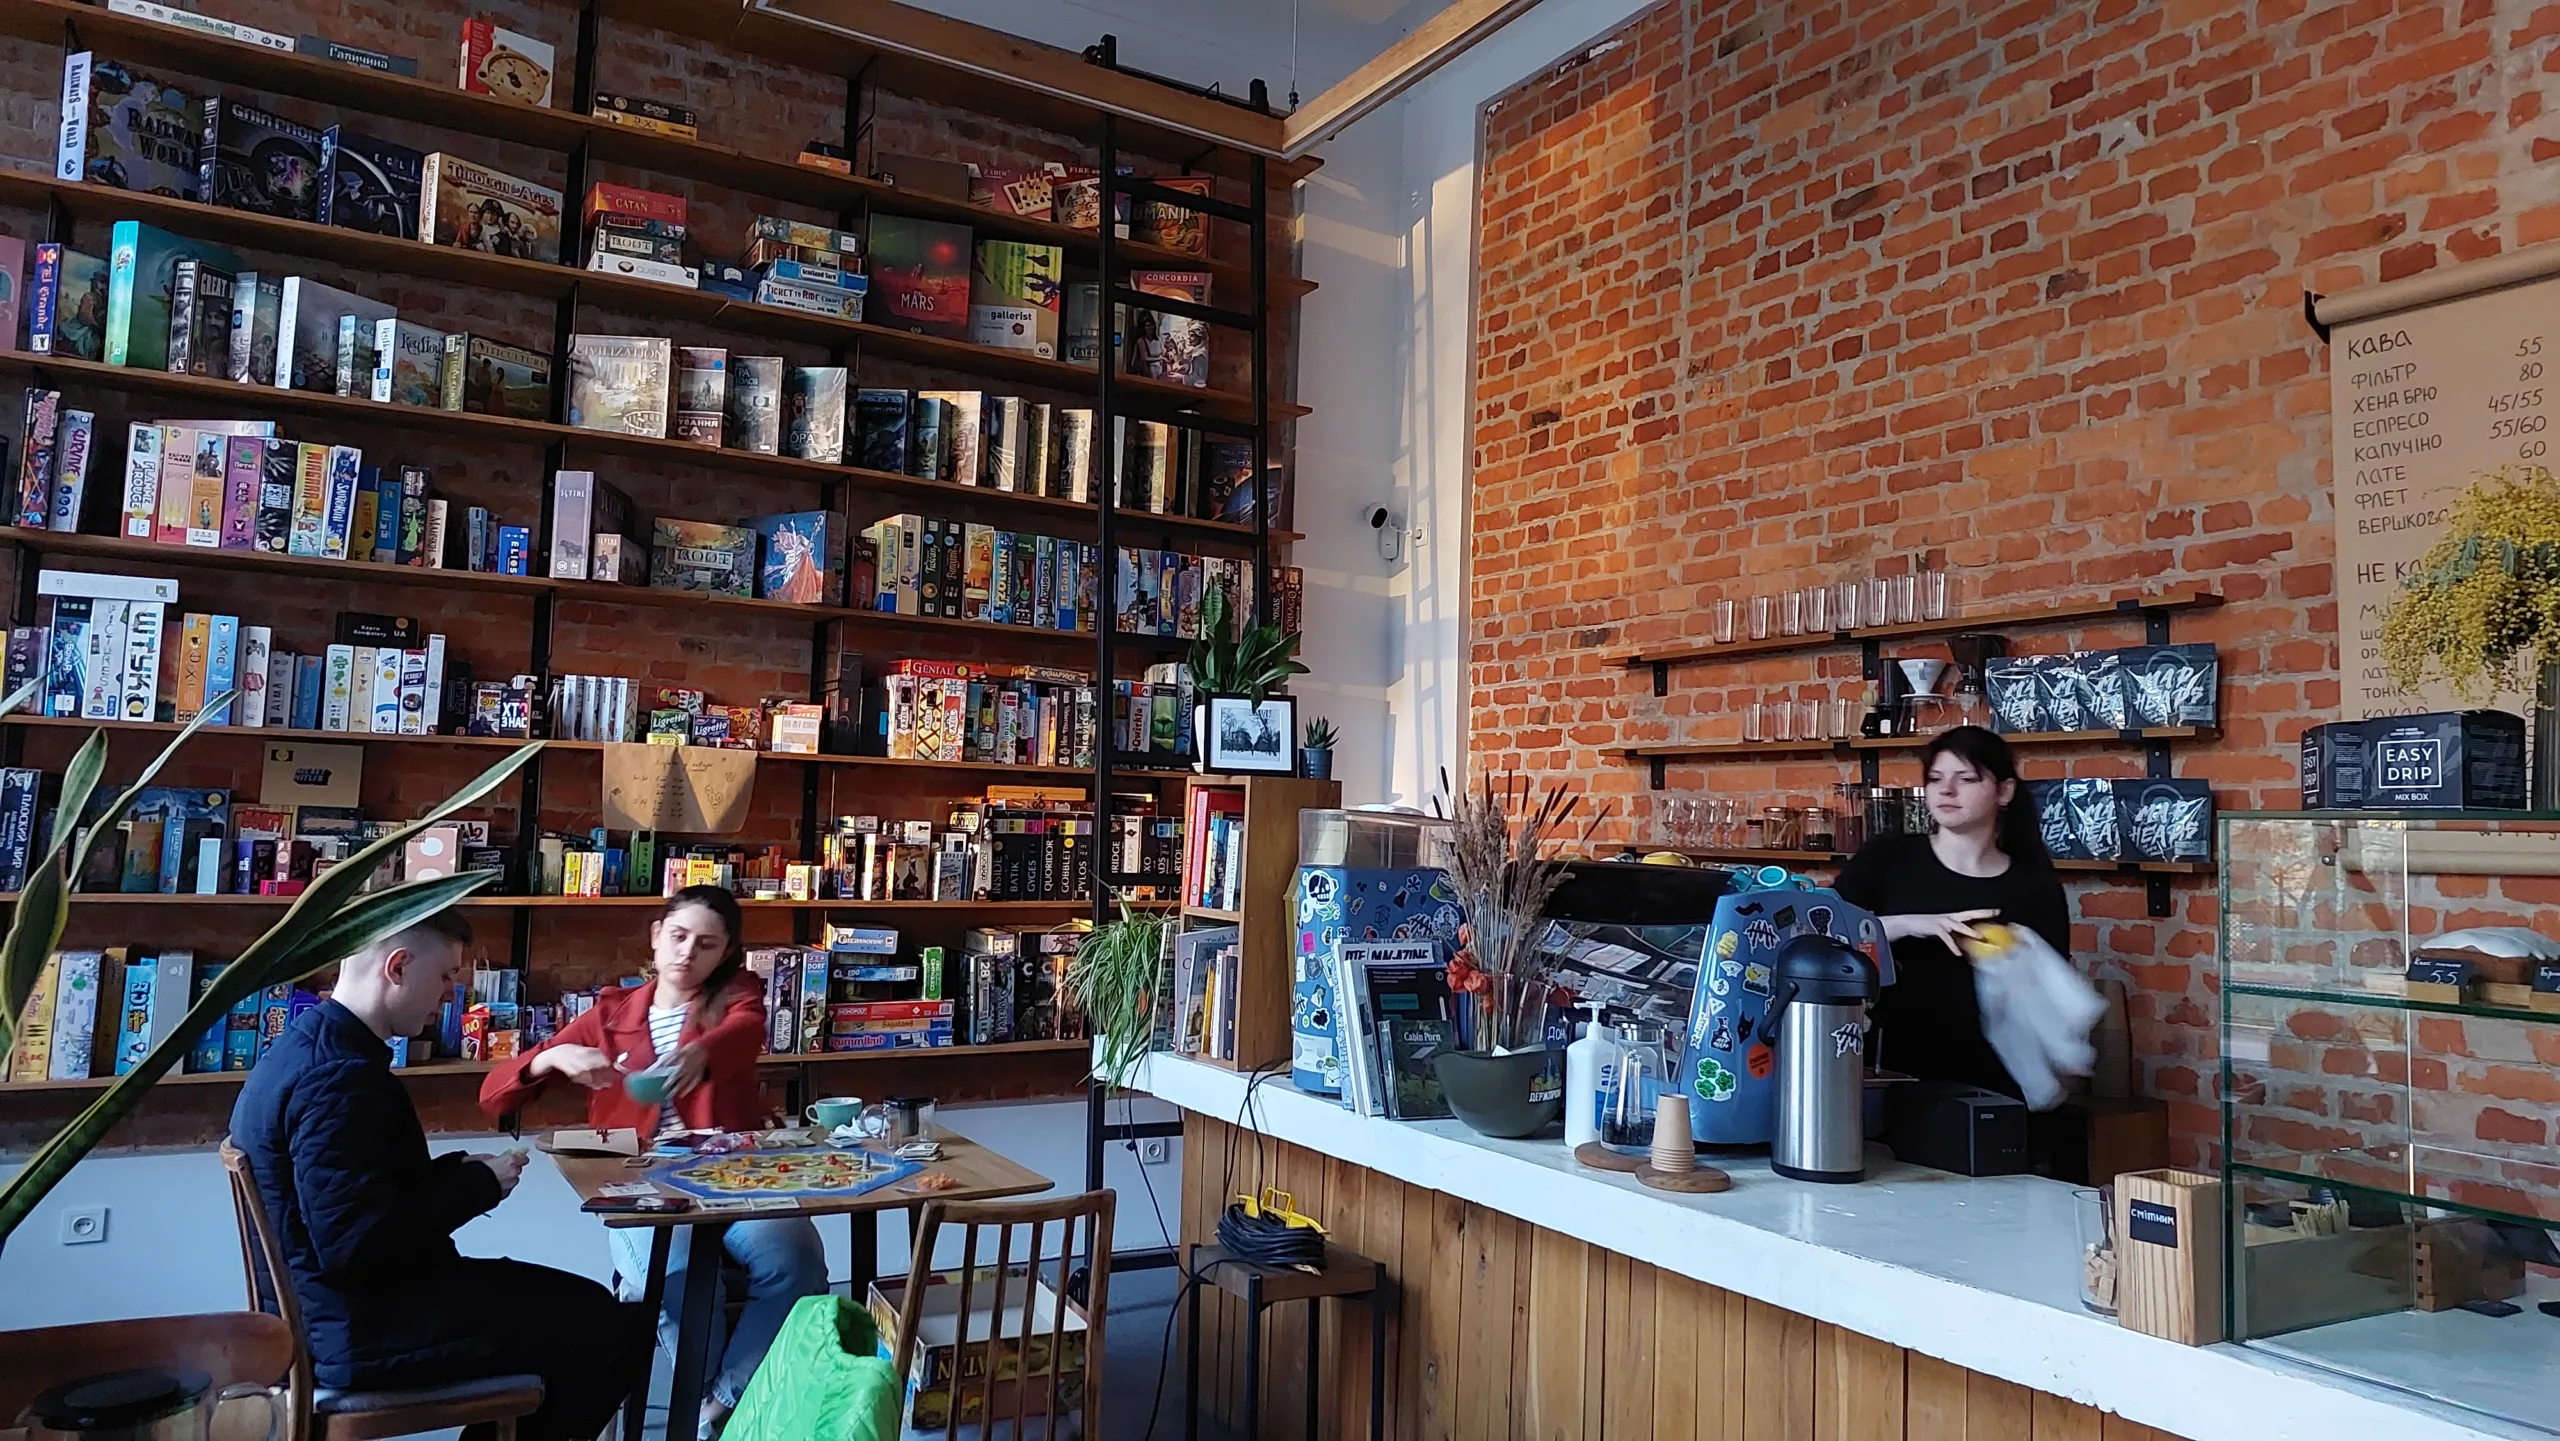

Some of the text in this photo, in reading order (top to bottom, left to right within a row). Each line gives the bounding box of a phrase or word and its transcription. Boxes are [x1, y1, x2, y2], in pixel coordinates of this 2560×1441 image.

[329, 46, 389, 70] Галичина
[69, 118, 80, 149] WORLD
[448, 161, 511, 192] THROUGH
[519, 184, 556, 209] AGES
[615, 197, 649, 214] CATAN
[1134, 206, 1192, 225] UMANJI
[200, 271, 228, 298] GREAT
[1146, 273, 1199, 283] CONCORDIA
[766, 283, 794, 298] TICKET
[802, 289, 821, 302] RIDE
[900, 292, 935, 311] MARS
[990, 310, 1033, 321] gallerist
[2514, 336, 2544, 358] 55
[2350, 362, 2544, 389] ФІЛЬТР 80
[2352, 386, 2545, 415] ХЕНД БРЮ 45/55
[2353, 411, 2547, 440] ЕСПРЕСО 55/60
[2354, 433, 2547, 463] КАПУЧІНО 60
[143, 460, 156, 505] FLAMME
[2355, 465, 2407, 487] ЛАТЕ
[560, 488, 586, 499] SCYTHE
[2354, 488, 2409, 511] ФЛЕТ
[676, 548, 733, 566] ROOT
[1059, 550, 1070, 592] DORADO
[2356, 562, 2387, 585] НЕ
[1285, 589, 1297, 634] TOBAGO
[394, 630, 407, 639] UA
[652, 713, 687, 729] Ligretto
[900, 708, 908, 727] AZUL
[949, 712, 957, 731] AZUL
[694, 720, 728, 737] Ligretto
[2386, 747, 2434, 763] EASY
[2387, 766, 2433, 781] DRIP
[2394, 792, 2430, 801] MIX BOX
[13, 792, 34, 870] ПЛОСКИЙ МИР
[994, 854, 1003, 894] INSIDE
[1026, 859, 1037, 893] GYGES
[1043, 839, 1054, 893] QUORIDOR
[1060, 848, 1072, 894] GOBBLET
[1009, 860, 1020, 893] BATIK
[1077, 860, 1088, 894] PYLOS
[837, 934, 885, 946] Carcassonne
[978, 961, 991, 979] 28
[2429, 969, 2458, 985] 55
[462, 1018, 481, 1037] UNO
[1403, 1030, 1443, 1043] Cabin Porn
[829, 1032, 887, 1049] Rummikub
